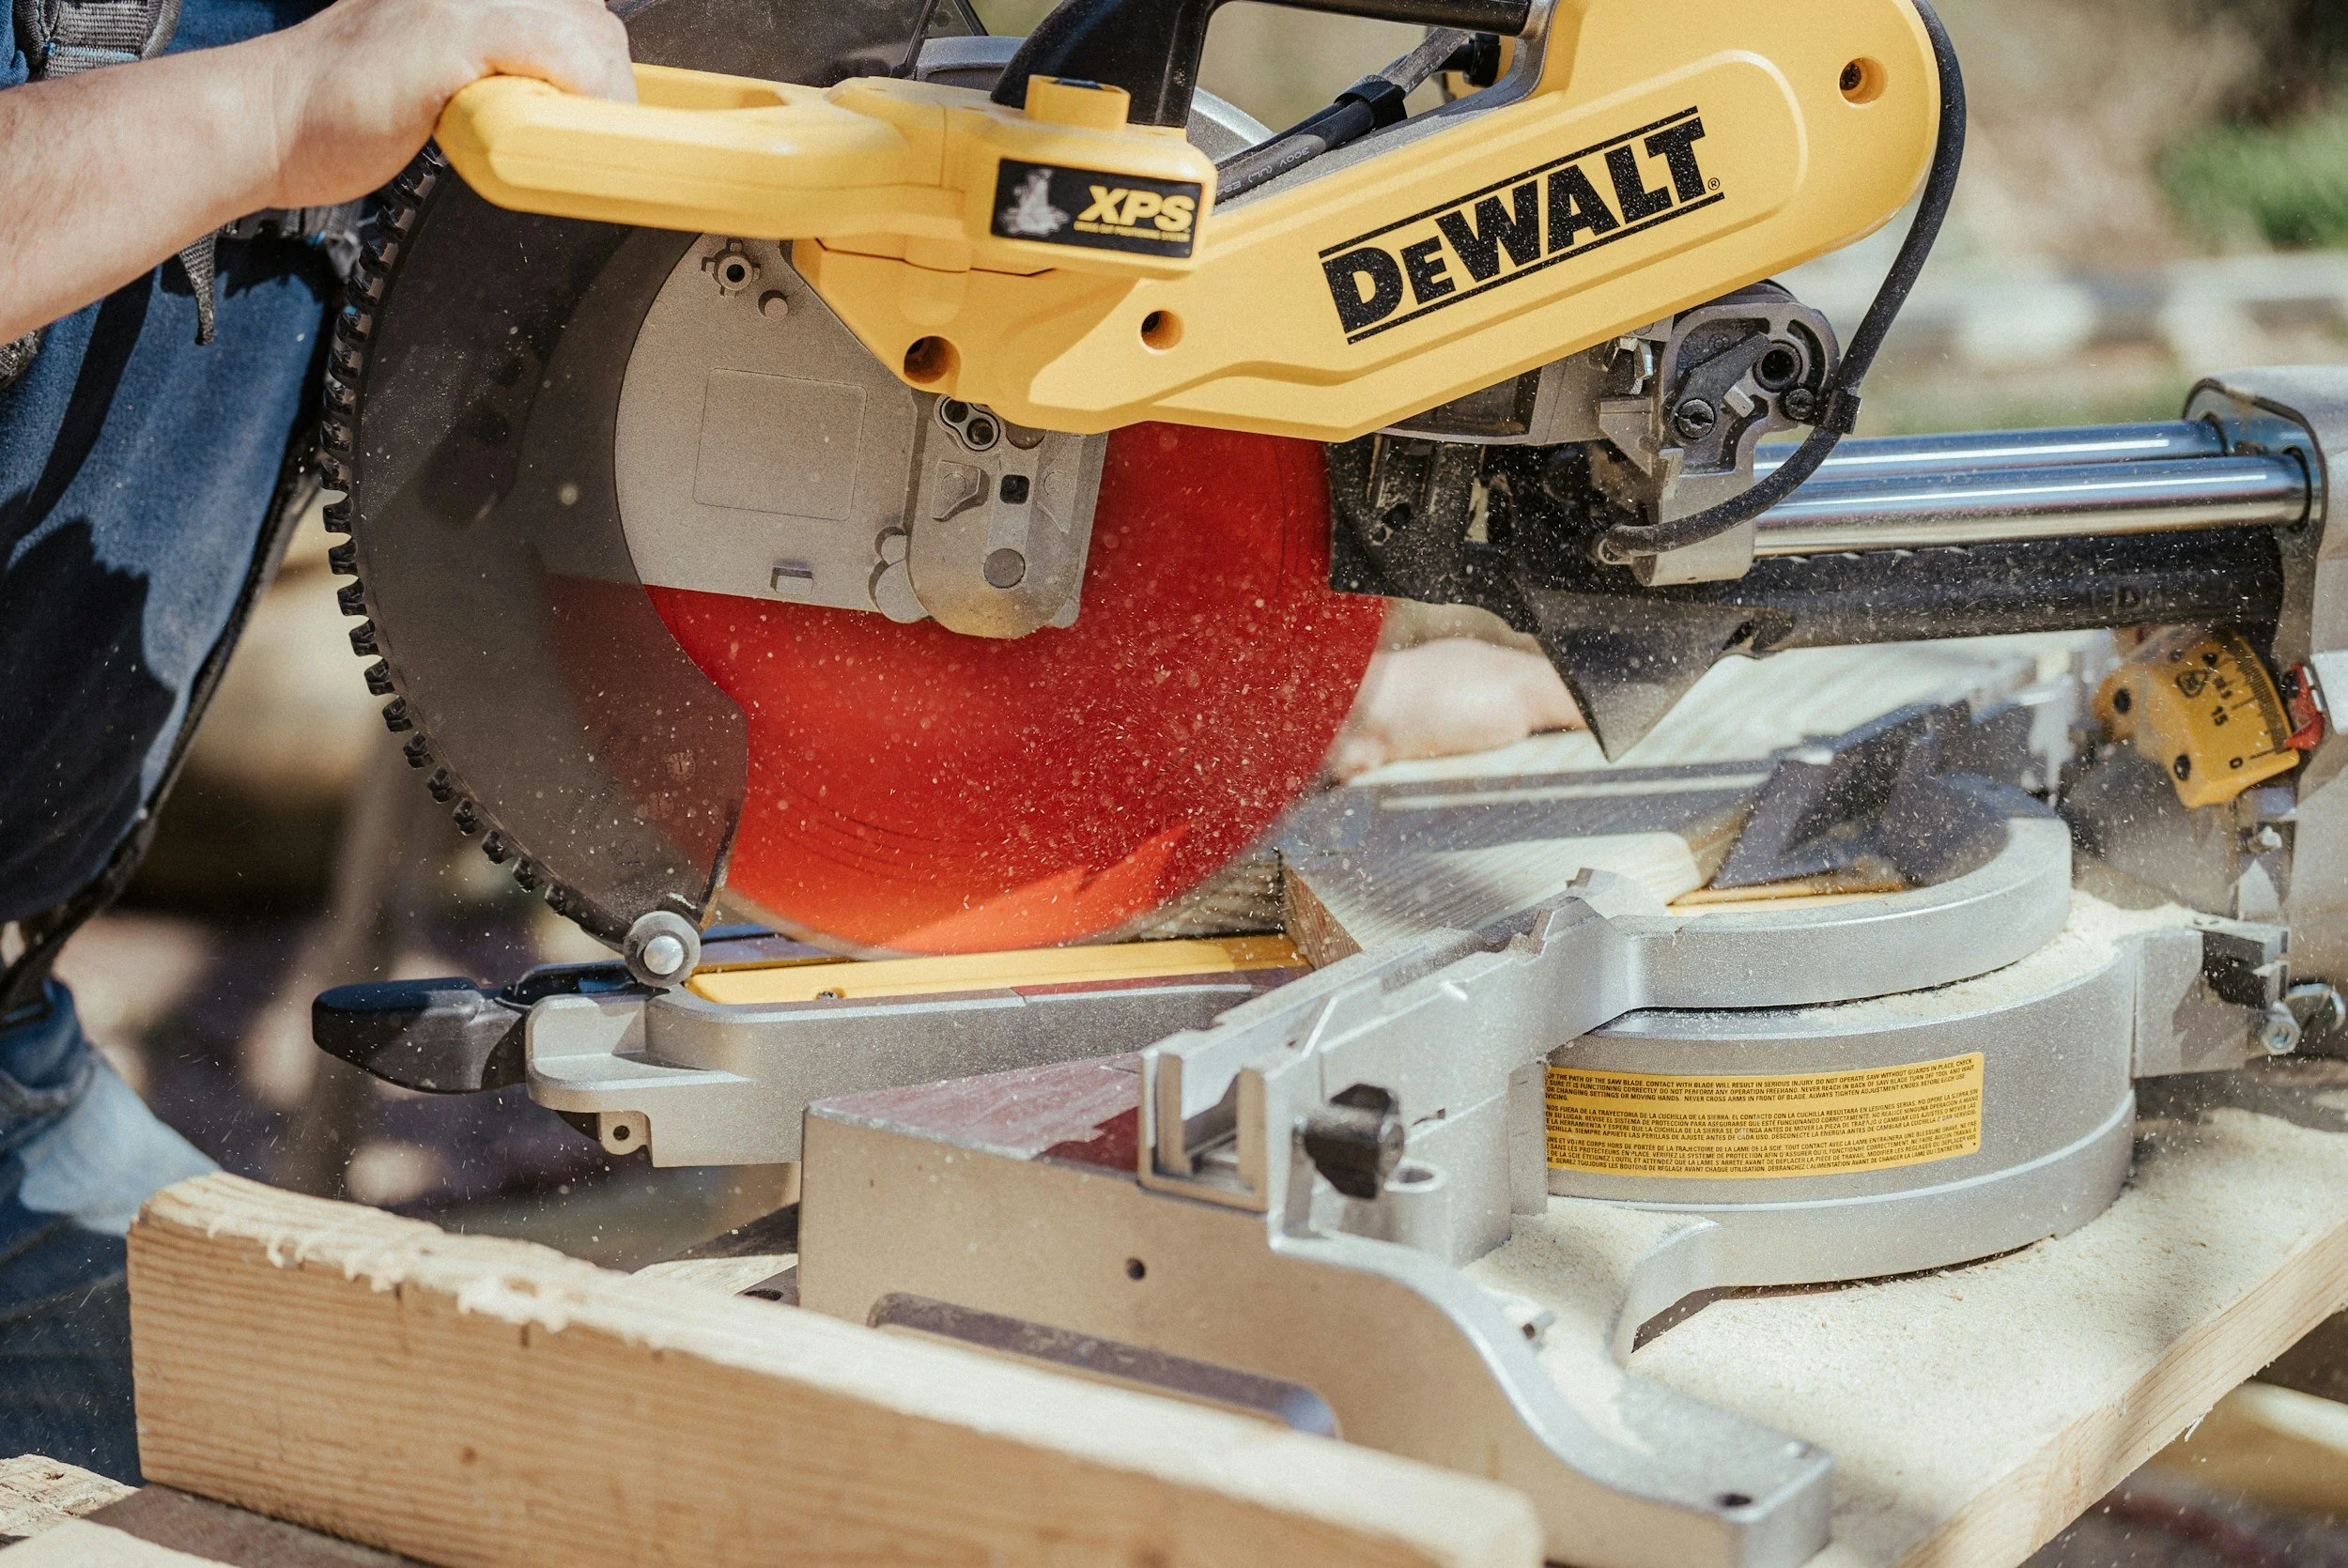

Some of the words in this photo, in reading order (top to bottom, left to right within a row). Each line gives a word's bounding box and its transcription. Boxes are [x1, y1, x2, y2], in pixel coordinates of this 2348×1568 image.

[1279, 146, 1310, 167] 300V
[1248, 165, 1273, 183] (UL)
[1076, 185, 1196, 232] XPS
[1322, 116, 1707, 334] DEWALT
[2211, 706, 2229, 727] 15
[1839, 1075, 1864, 1083] OPERATE
[1881, 1069, 1906, 1079] WITHOUT
[1907, 1066, 1930, 1075] GUARDS
[1556, 1087, 1588, 1096] CHANGING
[1589, 1090, 1619, 1099] SETTINGS
[1835, 1089, 1859, 1097] TIGHTEN
[1860, 1084, 1898, 1094] ADJUSTMENT
[1900, 1081, 1919, 1089] KNOBS
[1920, 1078, 1939, 1086] BEFORE
[1580, 1083, 1621, 1092] FUNCTIONING
[1890, 1076, 1907, 1084] BLADE
[1560, 1105, 1578, 1113] FUERA
[1598, 1109, 1638, 1118] TRAYECTORIA
[1559, 1119, 1601, 1129] HERRAMIENTA
[1574, 1127, 1601, 1136] SIEMPRE
[1579, 1146, 1619, 1155] PROTECTEURS
[1577, 1159, 1606, 1168] TOUJOURS
